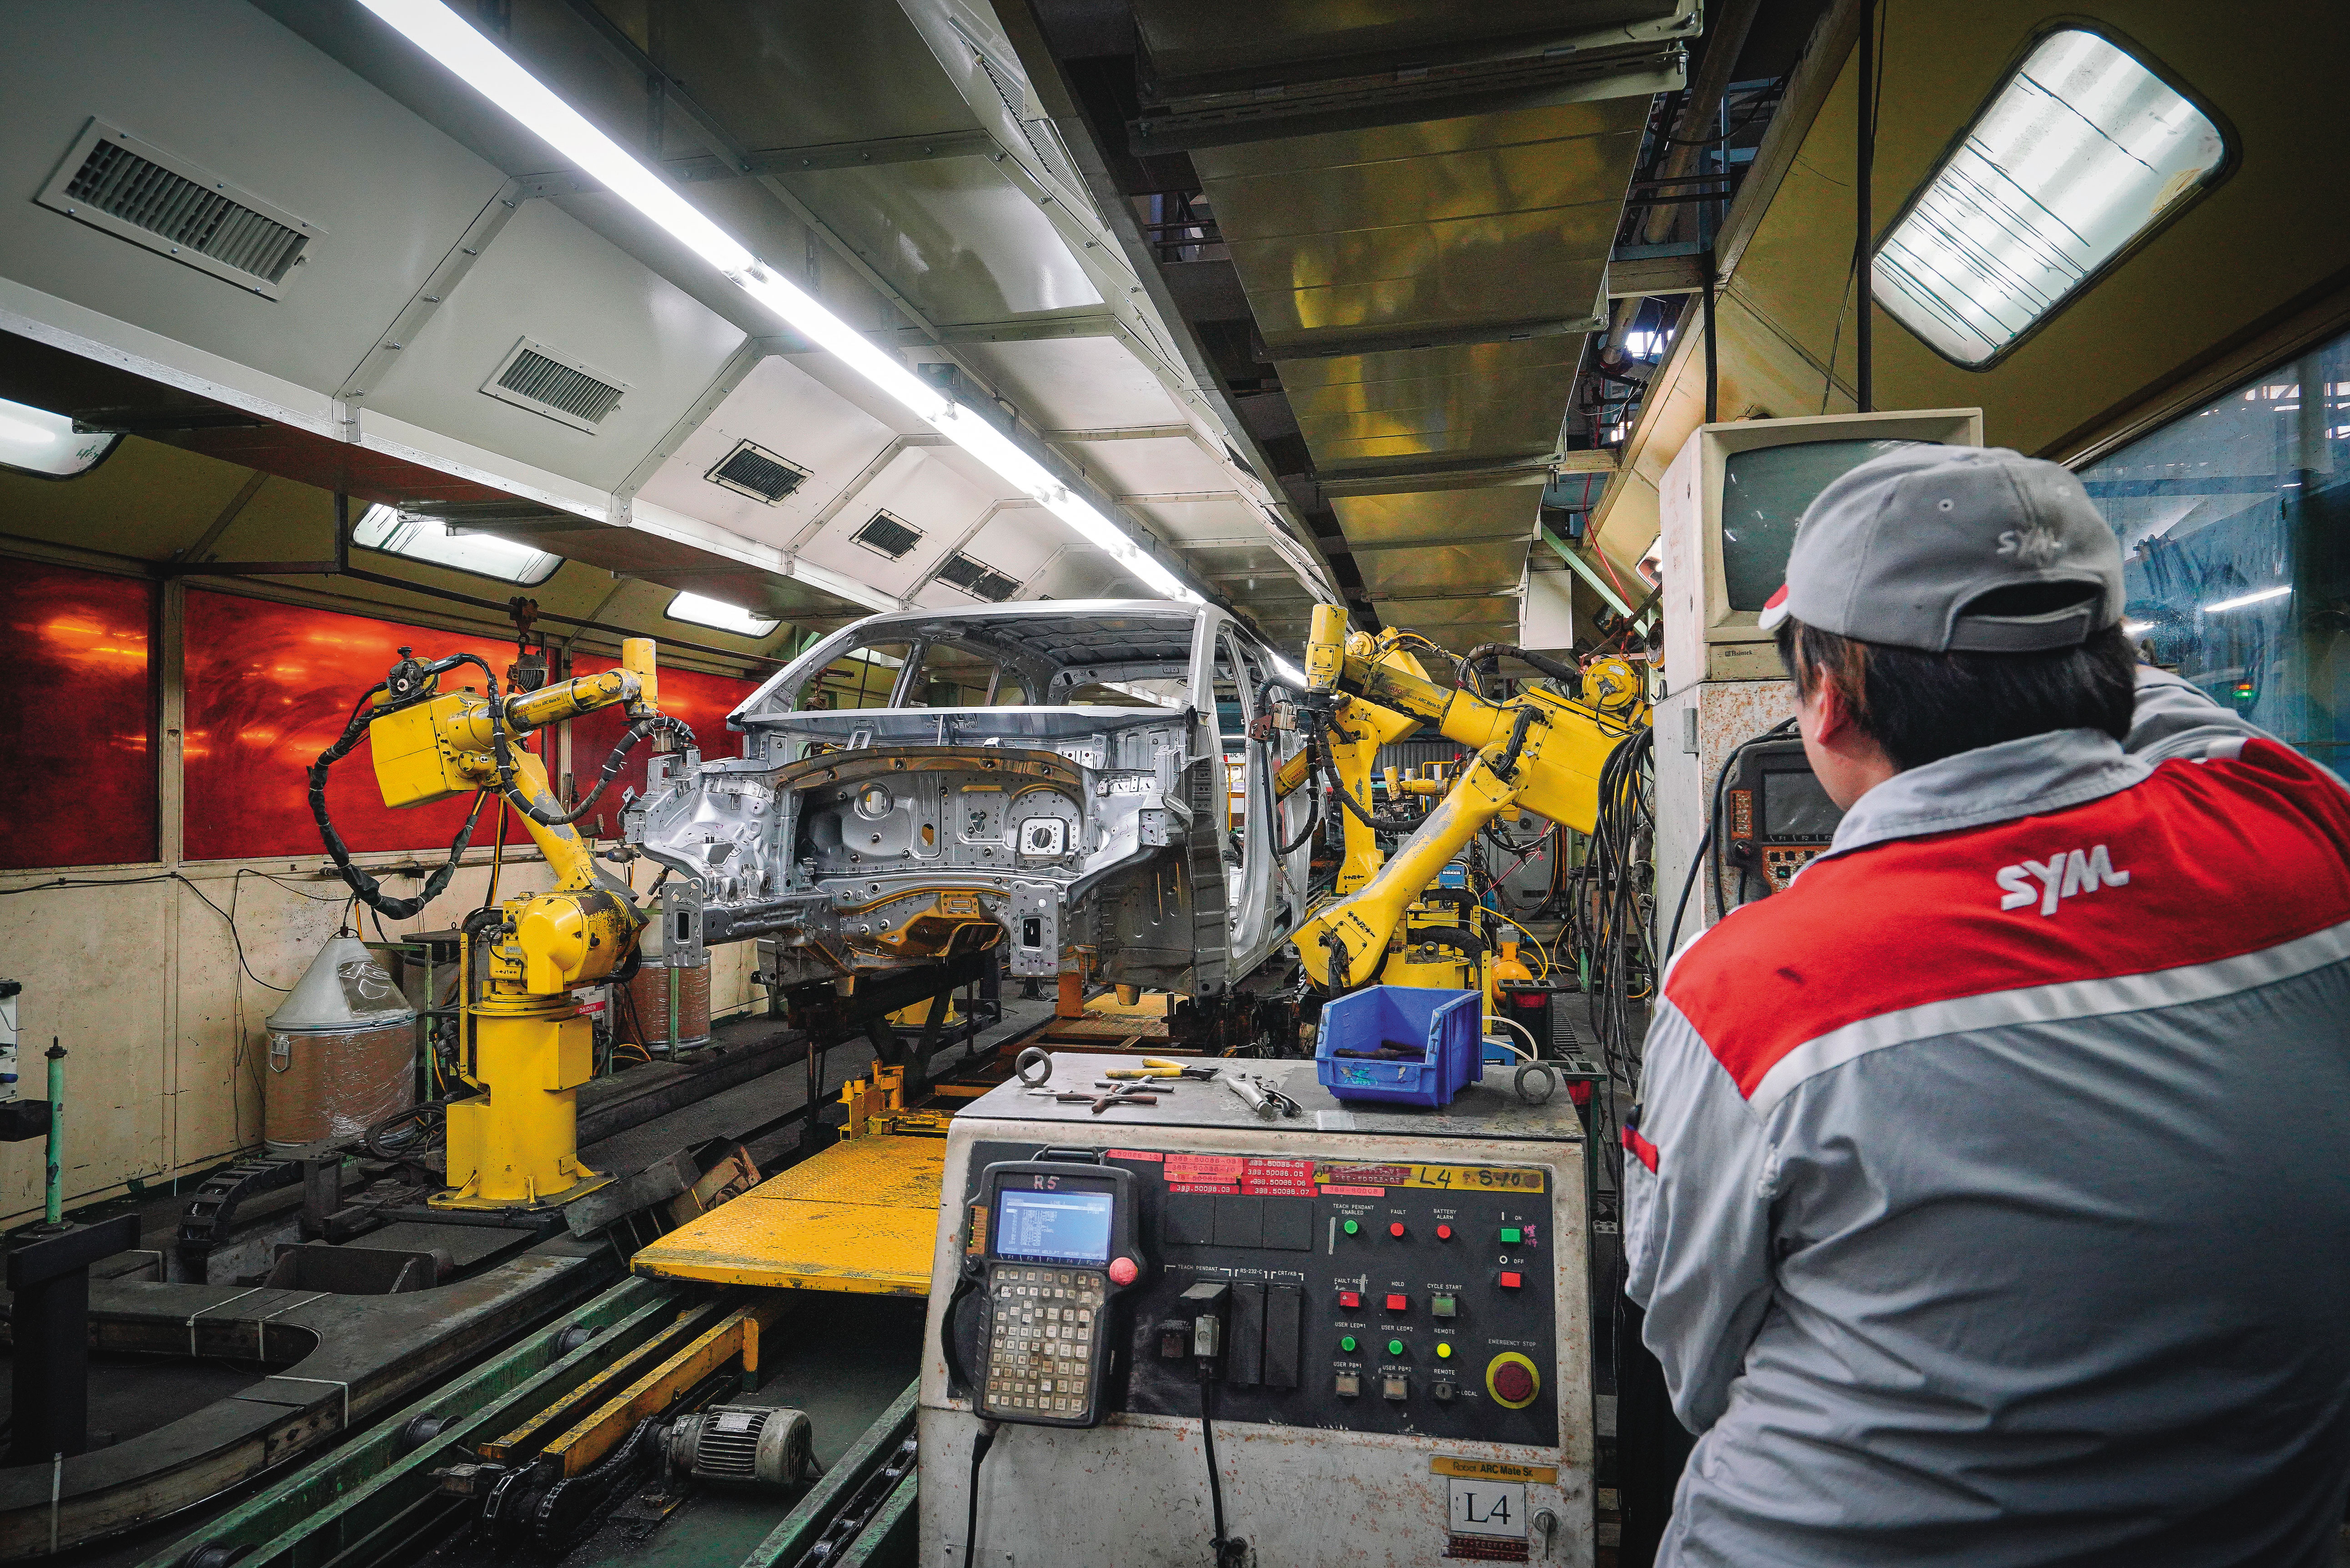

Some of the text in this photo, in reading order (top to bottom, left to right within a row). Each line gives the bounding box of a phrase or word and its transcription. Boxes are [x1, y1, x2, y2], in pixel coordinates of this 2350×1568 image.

[1291, 770, 1303, 780] FANUC
[1996, 844, 2130, 916] SYM
[579, 1005, 596, 1013] DAIDEN
[1420, 1166, 1452, 1190] L4
[1453, 1461, 1477, 1473] Robot
[1480, 1463, 1498, 1474] ARC
[1501, 1465, 1521, 1476] Mate
[1464, 1492, 1511, 1525] L4
